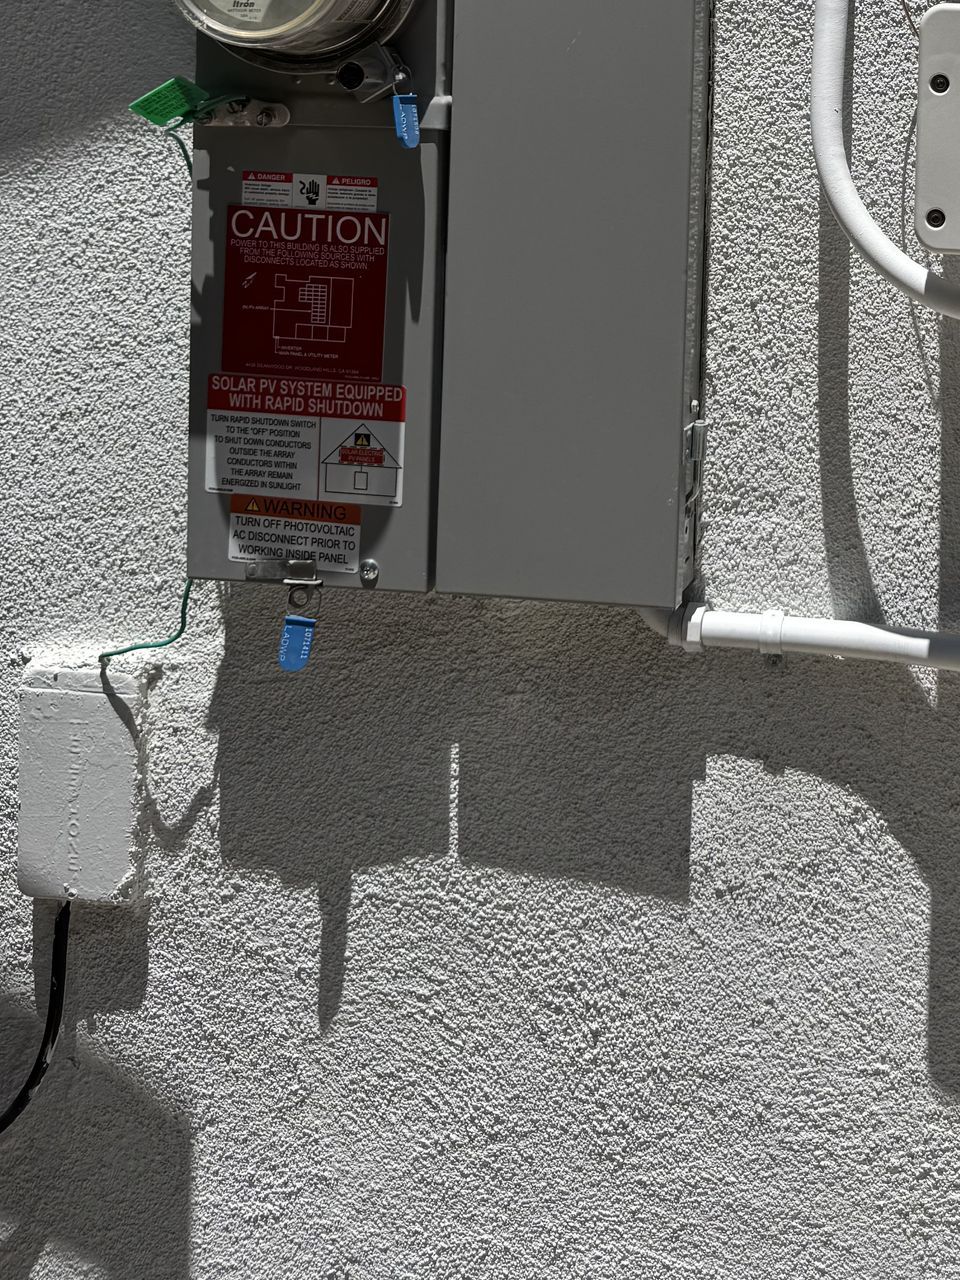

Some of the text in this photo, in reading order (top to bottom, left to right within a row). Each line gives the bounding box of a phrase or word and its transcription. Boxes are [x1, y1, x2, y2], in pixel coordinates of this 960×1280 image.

[342, 178, 371, 186] PELIGRO
[231, 209, 386, 245] CAUTION
[231, 239, 257, 247] POWER
[270, 241, 286, 249] THIS
[287, 242, 320, 252] BUILDING
[330, 245, 348, 253] ALSO
[350, 246, 385, 255] SUPPLIED
[240, 247, 260, 255] FROM
[277, 249, 319, 259] FOLLOWING
[321, 252, 355, 261] SOURCES
[357, 254, 375, 262] WITH
[244, 255, 295, 266] DISCONNECTS
[296, 259, 329, 268] LOCATED
[341, 261, 367, 270] SHOWN
[212, 375, 402, 401] SOLAR PV SYSTEM EQUIPPED
[229, 393, 384, 417] WITH RAPID SHUTDOWN
[211, 414, 316, 428] TURN RAPID SHUTDOWN SWITCH
[237, 426, 249, 434] THE
[269, 429, 300, 438] POSITION
[215, 435, 312, 449] TO SHUT DOWN CONDUCTORS
[229, 447, 295, 458] OUTSIDE THE ARRAY
[227, 457, 298, 469] CONDUCTORS WITHIN
[231, 468, 293, 479] THE ARRAY REMAIN
[221, 477, 301, 491] ENERGIZED IN SUNLIGHT
[264, 499, 346, 520] WARNING
[235, 516, 355, 536] TURN OFF PHOTOVOLTAIC
[233, 530, 355, 551] AC DISCONNECT PRIOR TO
[238, 543, 348, 564] WORKING INSIDE PANEL
[280, 625, 292, 662] LADWP
